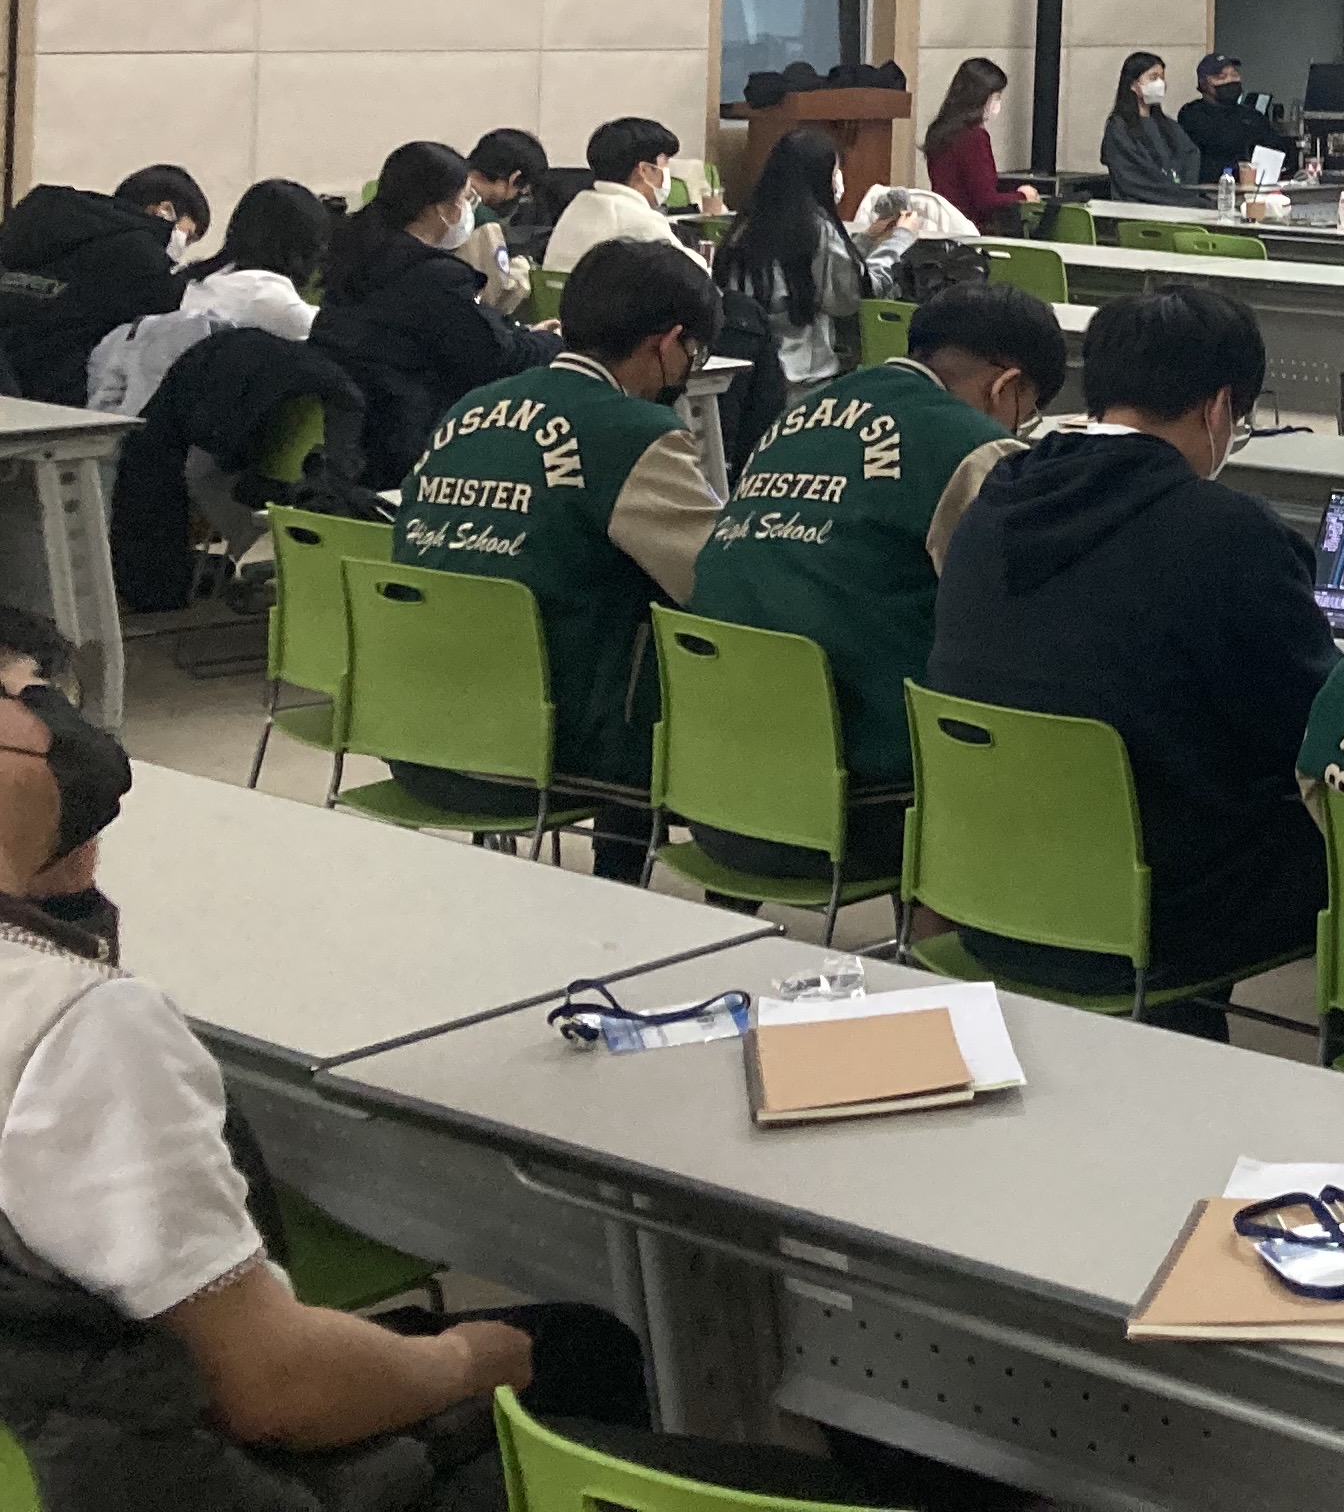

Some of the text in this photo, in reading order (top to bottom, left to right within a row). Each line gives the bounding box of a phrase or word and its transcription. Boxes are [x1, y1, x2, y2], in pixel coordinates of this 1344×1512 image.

[535, 416, 585, 488] SW
[741, 398, 901, 480] USAN SW
[417, 475, 532, 514] MEISTER
[733, 473, 847, 504] MEISTER
[406, 518, 527, 556] High School
[755, 512, 834, 545] School
